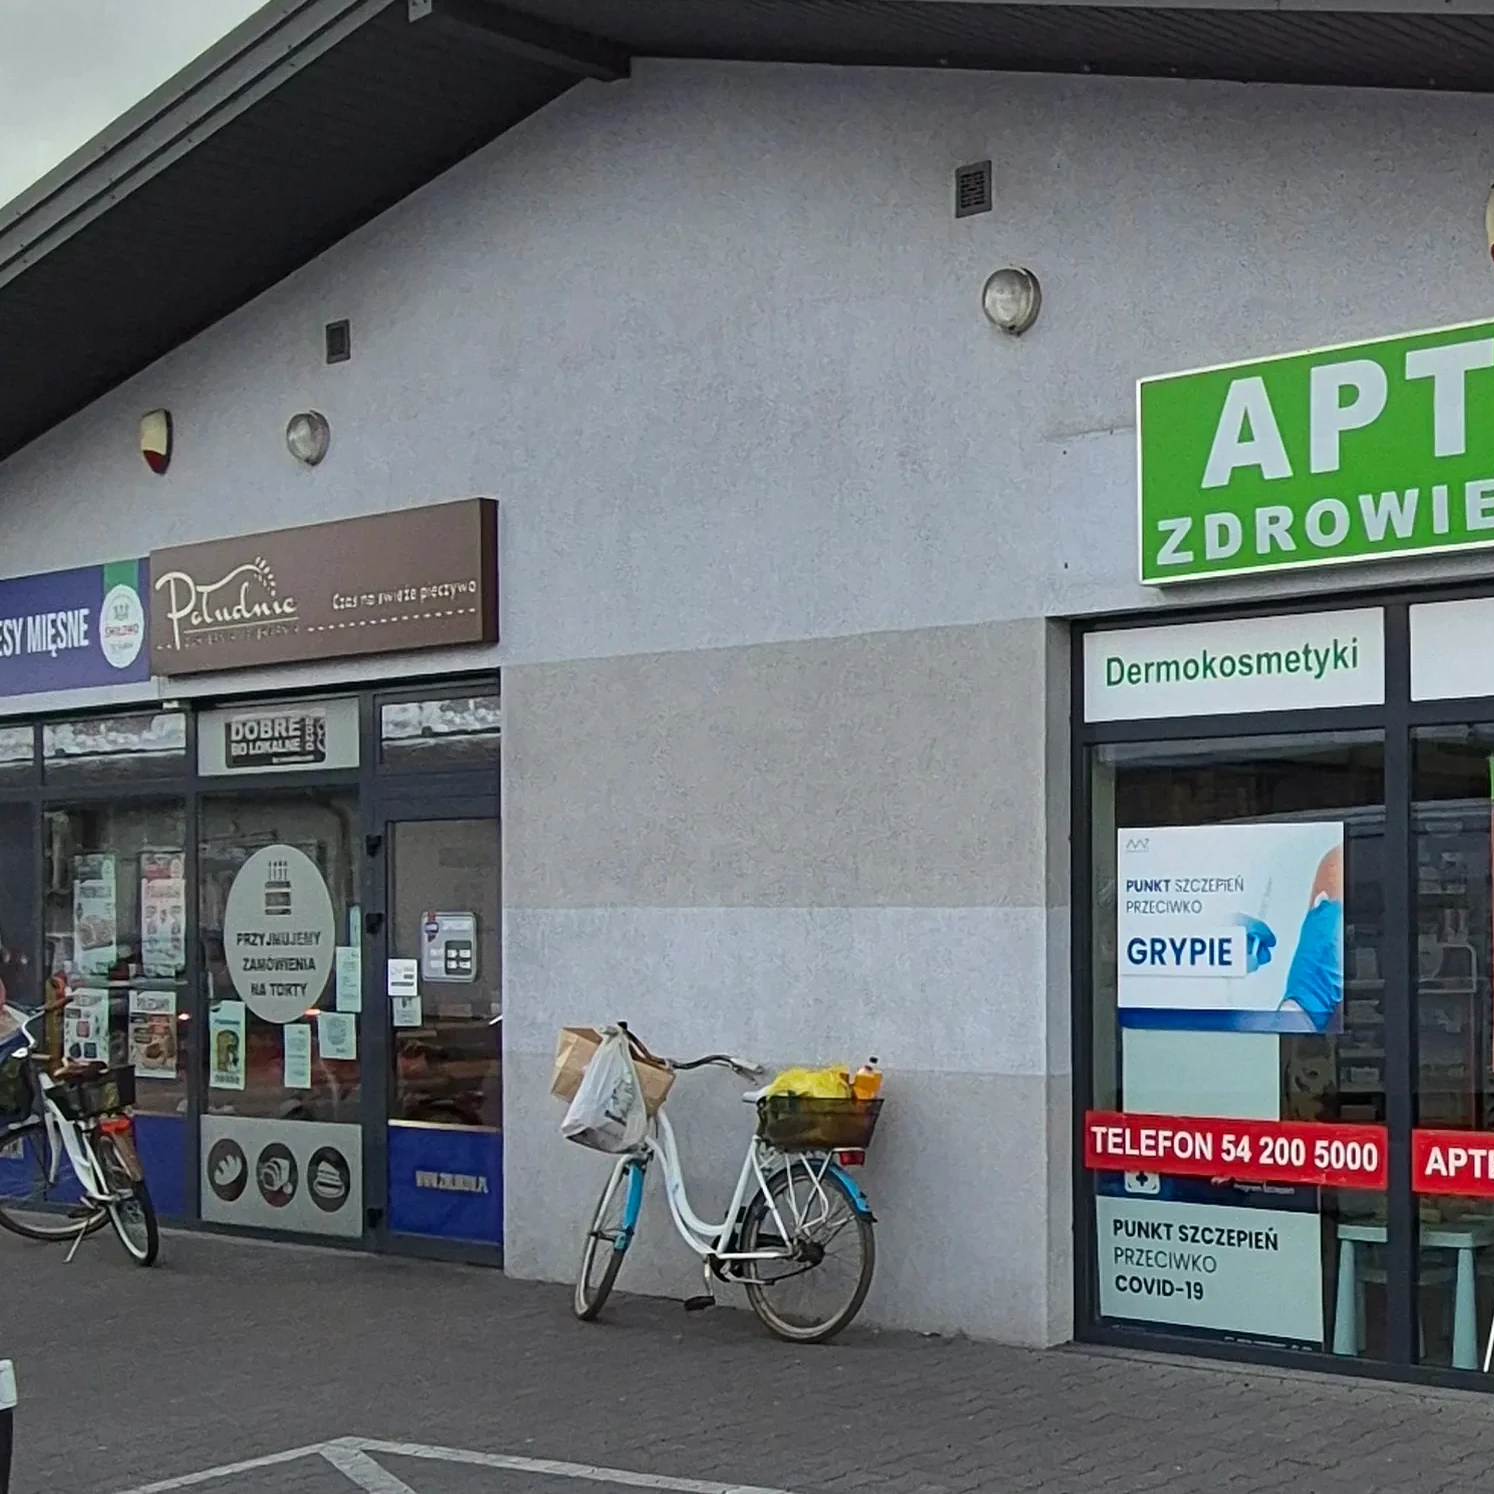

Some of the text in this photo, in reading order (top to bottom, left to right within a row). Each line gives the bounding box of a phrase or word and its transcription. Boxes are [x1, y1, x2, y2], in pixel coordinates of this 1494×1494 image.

[420, 580, 476, 603] pieczywo
[27, 608, 90, 657] MIĘSNE
[1106, 638, 1358, 687] Dermokosmetyki
[231, 718, 301, 740] DOBRE
[1126, 874, 1244, 893] PUNKT SZCZEPIEŃ
[1126, 900, 1202, 914] PRZECIWKO
[237, 931, 322, 947] PRZYJMUJEMY
[1127, 937, 1232, 966] GRYPIE
[242, 956, 316, 972] ZAMÓWIENIA
[251, 983, 308, 997] NA TORTY
[1090, 1126, 1378, 1172] TELEFON 54 200 5000
[1113, 1219, 1278, 1250] PUNKT SZCZEPIEŃ
[1114, 1247, 1217, 1274] PRZECIWKO
[1115, 1275, 1204, 1300] COVID-19
